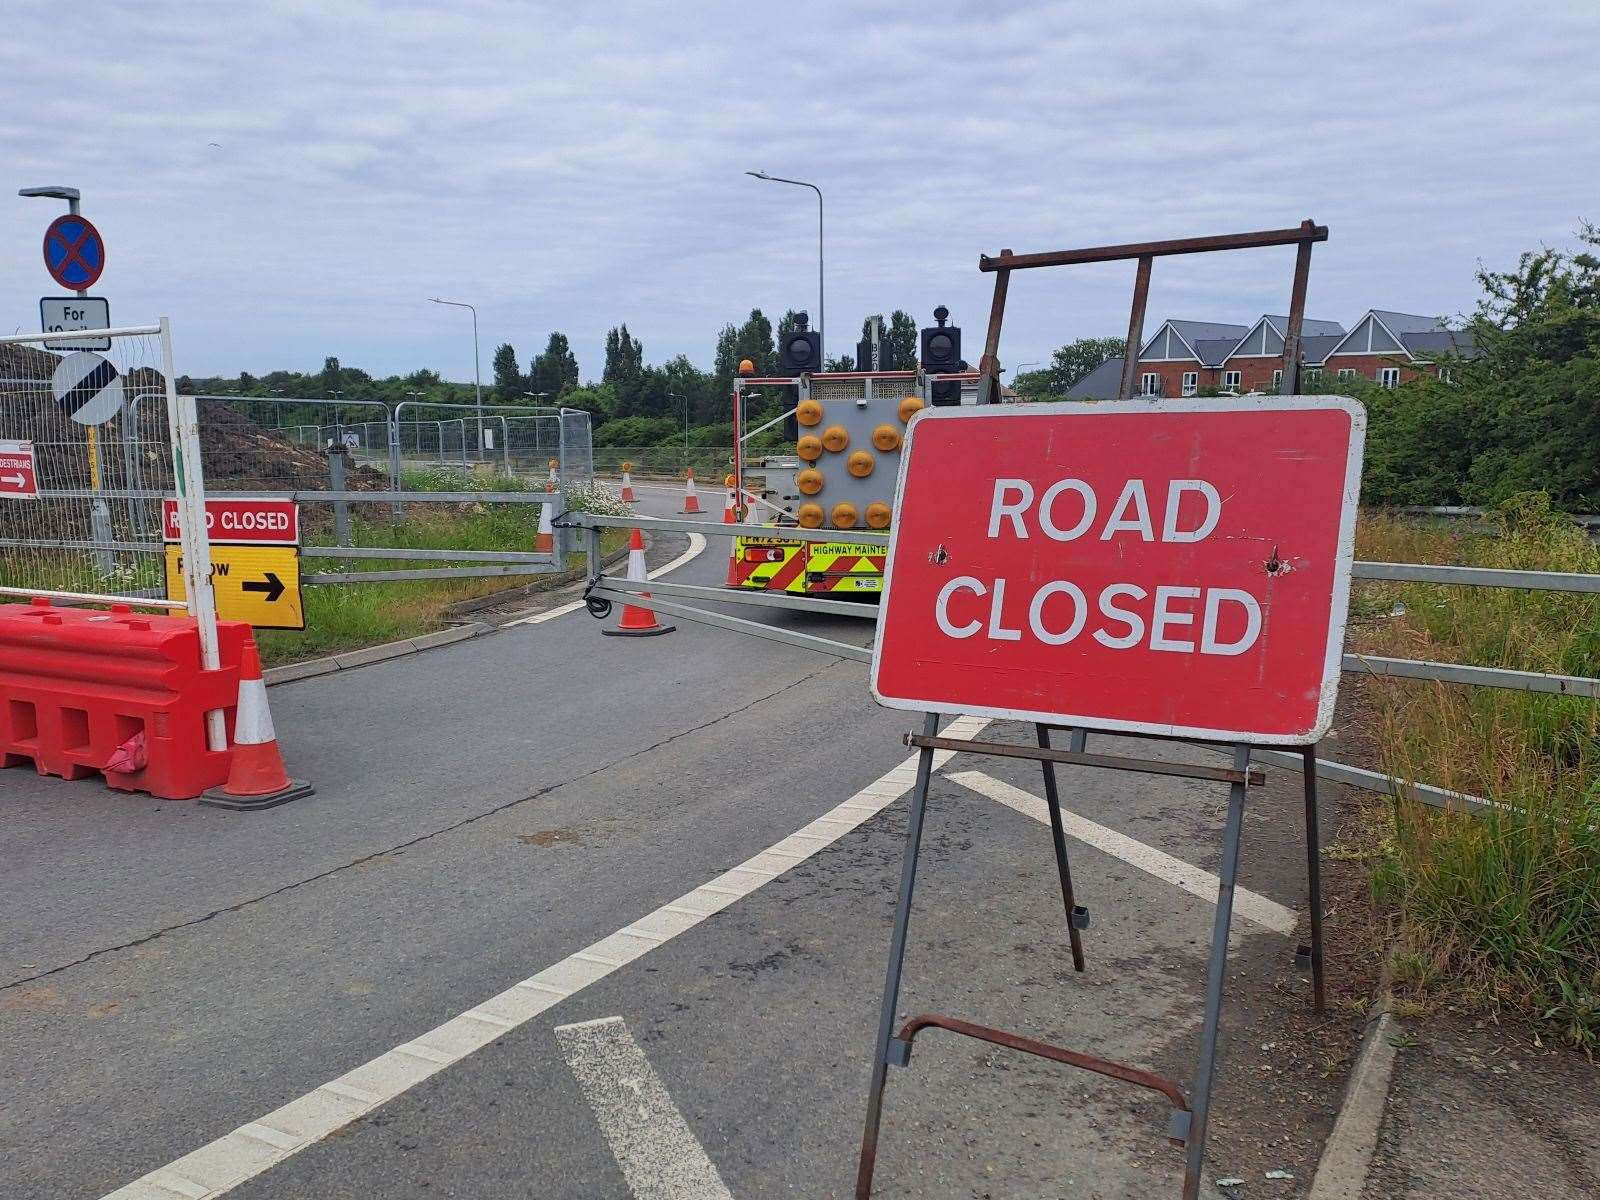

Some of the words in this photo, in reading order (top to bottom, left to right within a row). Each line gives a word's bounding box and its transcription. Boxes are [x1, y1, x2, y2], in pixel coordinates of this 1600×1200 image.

[63, 306, 85, 321] For
[987, 478, 1222, 543] ROAD
[169, 511, 215, 529] RD
[221, 511, 289, 530] CLOSED
[813, 545, 852, 555] HIGHWAY
[935, 576, 1262, 656] CLOSED
